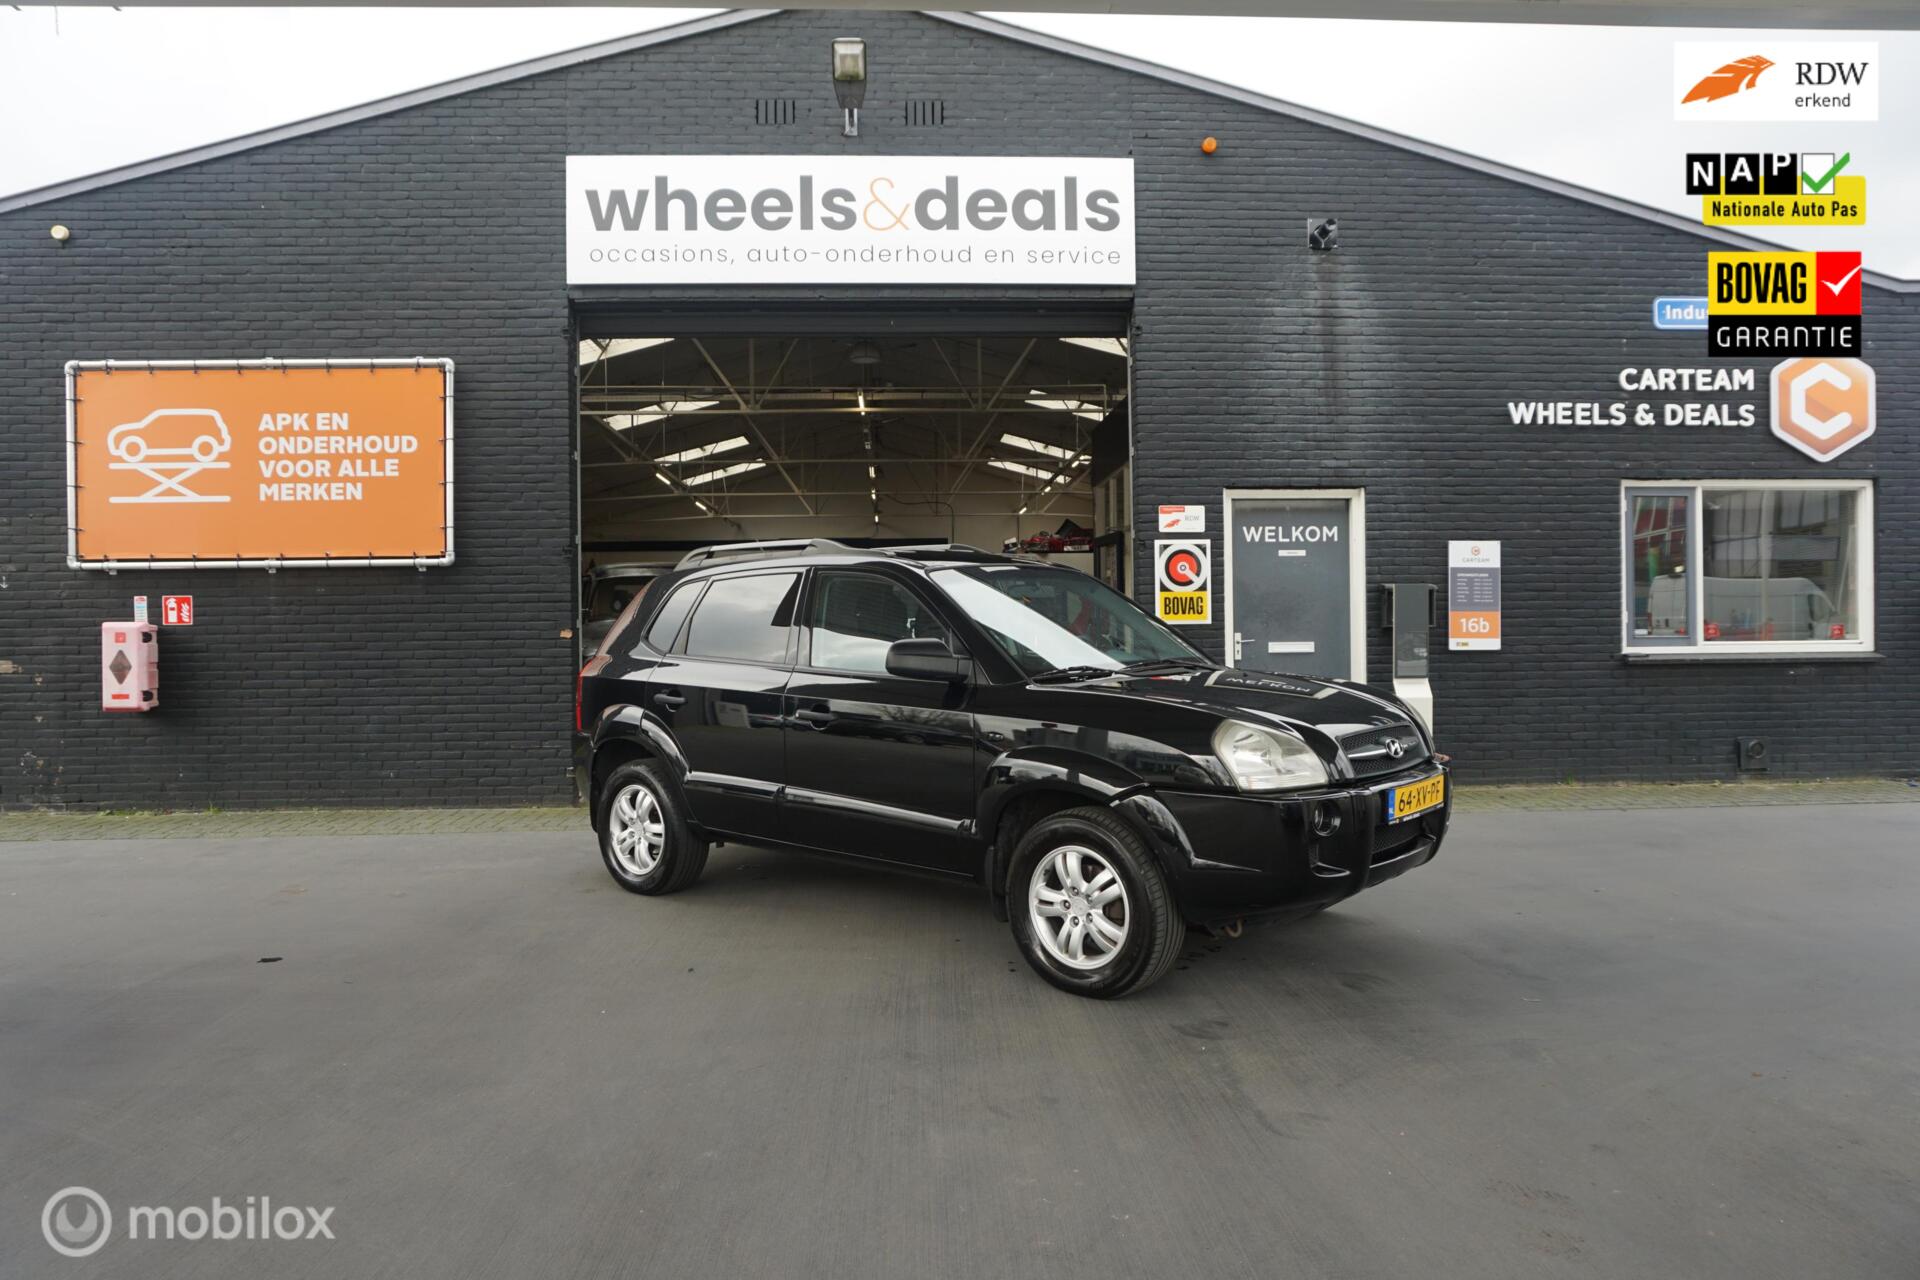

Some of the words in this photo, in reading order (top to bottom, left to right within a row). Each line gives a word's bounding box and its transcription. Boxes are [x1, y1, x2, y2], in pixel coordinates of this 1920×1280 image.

[585, 174, 1120, 231] wheels&deals
[589, 243, 736, 266] occasions,
[746, 244, 972, 264] auto-onderhoud
[983, 248, 1015, 264] en
[1026, 246, 1121, 265] service
[1665, 304, 1708, 320] Indu
[1619, 367, 1755, 391] CARTEAM
[259, 413, 310, 432] APK
[316, 412, 349, 431] EN
[1508, 402, 1627, 426] WHEELS
[1634, 403, 1656, 427] &
[1664, 403, 1756, 427] DEALS
[258, 435, 418, 456] ONDERHOUD
[259, 460, 331, 479] VOOR
[338, 459, 399, 477] ALLE
[259, 482, 363, 502] MERKEN
[1242, 525, 1339, 543] WELKOM
[1163, 596, 1204, 616] BOVAG
[1459, 617, 1490, 633] 16b
[1398, 780, 1441, 813] 64-XV-PF
